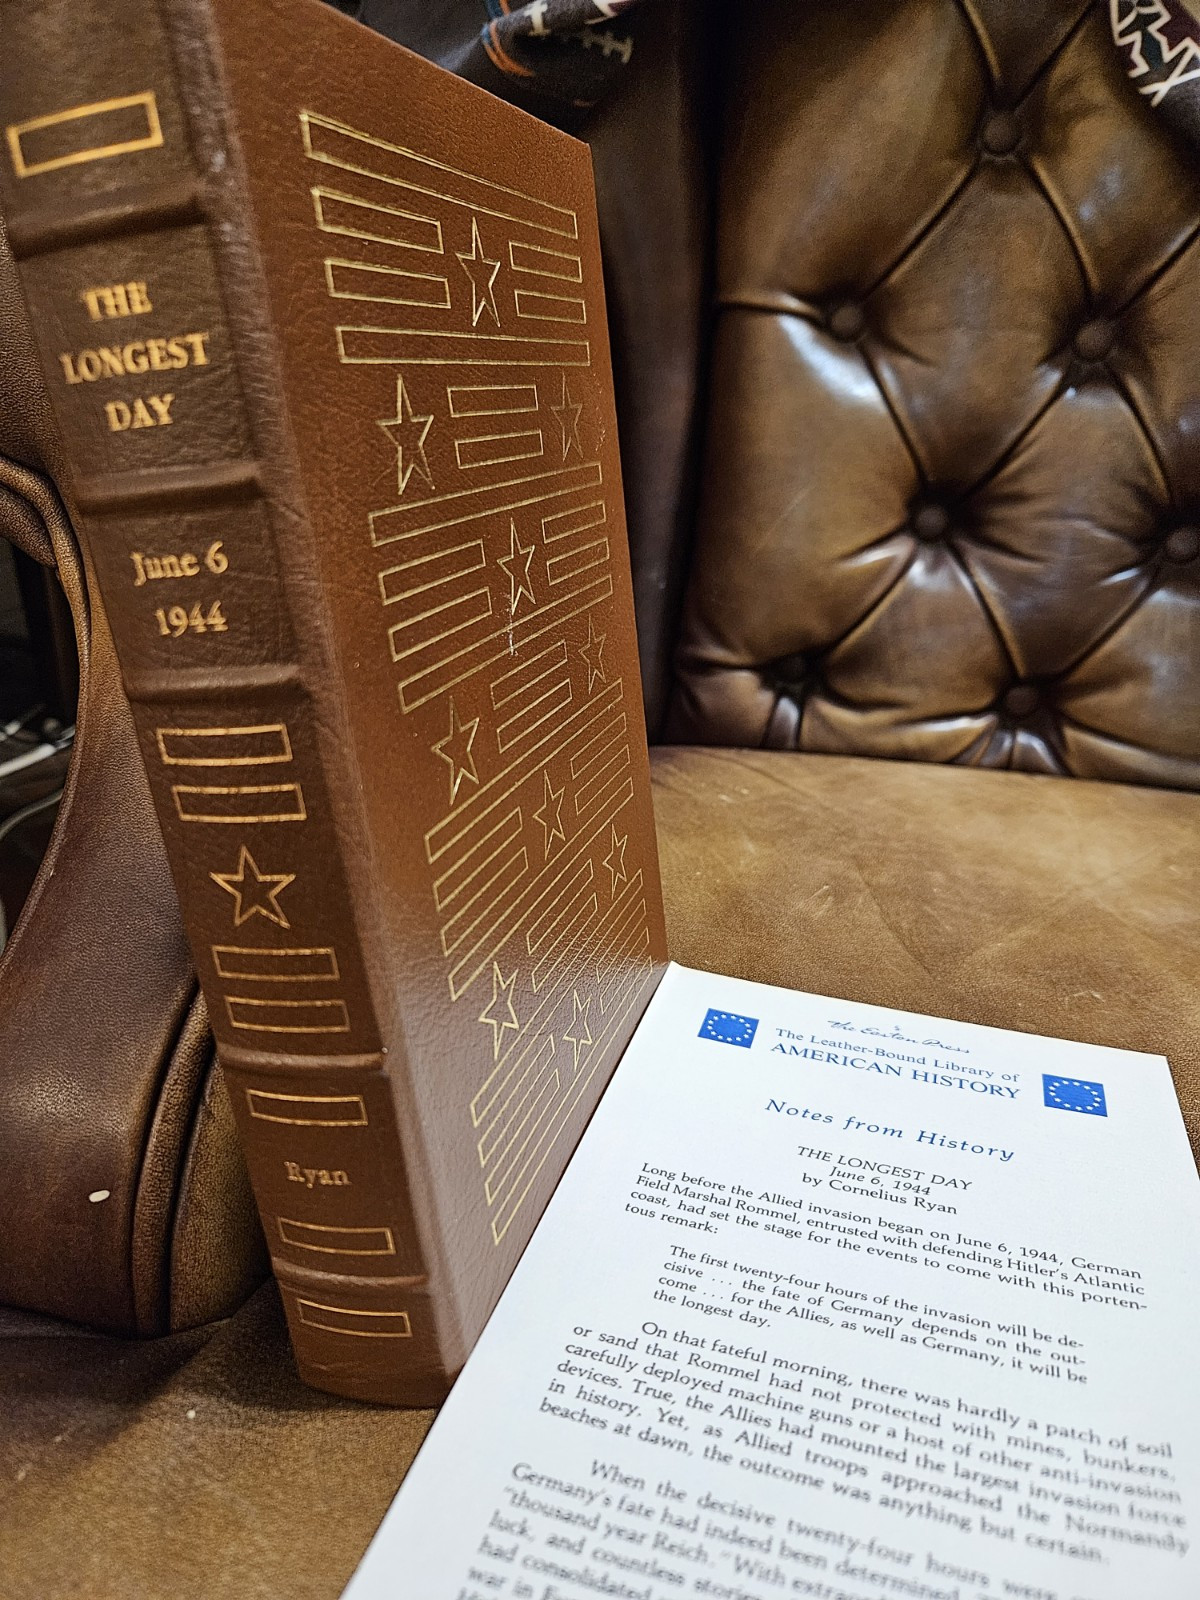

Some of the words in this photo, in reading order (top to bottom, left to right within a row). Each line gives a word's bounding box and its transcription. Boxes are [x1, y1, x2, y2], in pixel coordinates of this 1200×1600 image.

[81, 281, 153, 322] THE
[60, 332, 210, 385] LONGEST
[104, 393, 175, 432] DAY
[130, 551, 200, 587] June
[204, 540, 230, 574] 6
[154, 600, 229, 638] 1944
[771, 1042, 903, 1077] AMERICAN
[912, 1069, 1021, 1099] HISTORY
[776, 1028, 804, 1041] The
[810, 1035, 926, 1065] Leather-Bound
[934, 1059, 994, 1079] Library
[1001, 1073, 1020, 1082] of
[764, 1098, 833, 1123] Notes
[842, 1116, 902, 1138] from
[915, 1129, 1014, 1162] History
[797, 1145, 833, 1162] THE
[836, 1154, 925, 1181] LONGEST
[930, 1174, 972, 1190] DAY
[802, 1172, 823, 1187] by
[828, 1179, 907, 1204] Cornelius
[914, 1196, 957, 1215] Ryan
[828, 1165, 865, 1182] June
[870, 1176, 884, 1187] 6,
[892, 1180, 930, 1195] 1944
[624, 1203, 656, 1218] tous
[660, 1213, 718, 1234] remark:
[630, 1191, 670, 1208] coast,
[676, 1199, 706, 1215] had
[709, 1211, 729, 1221] set
[735, 1214, 759, 1228] the
[763, 1223, 802, 1239] stage
[807, 1230, 831, 1244] for
[836, 1237, 861, 1252] the
[866, 1246, 918, 1264] events
[924, 1257, 940, 1268] to
[946, 1263, 991, 1279] come
[997, 1274, 1036, 1289] with
[1043, 1281, 1074, 1297] this
[1081, 1291, 1147, 1310] porten-
[636, 1174, 670, 1192] Field
[672, 1184, 732, 1207] Marshal
[734, 1198, 800, 1224] Rommel,
[806, 1218, 878, 1240] entrusted
[882, 1235, 917, 1249] with
[922, 1241, 1003, 1268] defending
[1007, 1257, 1068, 1280] Hitler's
[1073, 1272, 1144, 1295] Atlantic
[641, 1162, 676, 1181] Long
[681, 1171, 726, 1191] before
[730, 1184, 753, 1198] the
[757, 1191, 803, 1209] Allied
[808, 1202, 871, 1224] invasion
[878, 1216, 923, 1236] began
[929, 1231, 950, 1241] on
[955, 1233, 992, 1250] June
[997, 1242, 1012, 1255] 6,
[1019, 1246, 1063, 1266] 1944,
[1071, 1256, 1141, 1279] German
[653, 1289, 676, 1304] the
[680, 1295, 733, 1318] longest
[738, 1310, 770, 1328] day.
[663, 1261, 703, 1278] cisive
[742, 1279, 765, 1293] the
[771, 1285, 800, 1301] fate
[807, 1296, 824, 1306] of
[830, 1299, 903, 1326] Germany
[911, 1317, 977, 1342] depends
[985, 1337, 1006, 1349] on
[1015, 1341, 1041, 1356] the
[1050, 1352, 1085, 1364] out-
[670, 1244, 696, 1261] The
[699, 1252, 728, 1269] first
[733, 1262, 821, 1290] twenty-four
[824, 1281, 868, 1301] hours
[872, 1294, 890, 1306] of
[894, 1298, 918, 1312] the
[923, 1304, 991, 1329] invasion
[997, 1323, 1026, 1337] will
[1032, 1327, 1052, 1342] be
[1057, 1334, 1084, 1348] de-
[658, 1276, 697, 1292] come
[730, 1291, 754, 1306] for
[758, 1298, 782, 1313] the
[785, 1306, 834, 1327] Allies,
[840, 1320, 857, 1331] as
[863, 1325, 895, 1339] well
[900, 1334, 917, 1345] as
[922, 1336, 1004, 1367] Germany,
[1012, 1356, 1022, 1369] it
[1029, 1363, 1060, 1378] will
[1067, 1368, 1087, 1384] be
[565, 1344, 638, 1373] carefully
[643, 1363, 724, 1393] deployed
[728, 1387, 804, 1414] machine
[808, 1408, 853, 1427] guns
[859, 1421, 880, 1434] or
[886, 1428, 896, 1438] a
[904, 1426, 943, 1450] host
[952, 1443, 971, 1457] of
[979, 1450, 1031, 1472] other
[573, 1326, 592, 1337] or
[598, 1333, 639, 1350] sand
[645, 1342, 678, 1361] that
[687, 1352, 760, 1382] Rommel
[768, 1372, 803, 1392] had
[811, 1387, 841, 1402] not
[851, 1397, 941, 1427] protected
[952, 1422, 995, 1441] with
[1006, 1435, 1071, 1462] mines,
[641, 1321, 667, 1339] On
[672, 1330, 706, 1348] that
[710, 1338, 767, 1364] fateful
[772, 1357, 852, 1387] morning,
[861, 1377, 908, 1398] there
[914, 1391, 950, 1409] was
[957, 1397, 1020, 1428] hardly
[1027, 1419, 1038, 1430] a
[1046, 1424, 1101, 1445] patch
[1108, 1435, 1127, 1451] of
[539, 1396, 608, 1430] beaches
[612, 1424, 631, 1436] at
[637, 1426, 693, 1456] dawn,
[702, 1444, 733, 1465] the
[739, 1458, 824, 1489] outcome
[832, 1481, 871, 1503] was
[878, 1496, 971, 1534] anything
[980, 1515, 1015, 1542] but
[548, 1378, 565, 1394] in
[575, 1384, 641, 1417] history.
[658, 1406, 688, 1431] Yet,
[702, 1425, 722, 1438] as
[734, 1430, 793, 1456] Allied
[805, 1449, 868, 1477] troops
[881, 1472, 1002, 1512] approached
[1017, 1502, 1050, 1525] the
[557, 1359, 622, 1389] devices.
[632, 1378, 676, 1405] True,
[685, 1394, 714, 1412] the
[719, 1404, 771, 1428] Allies
[778, 1416, 814, 1439] had
[820, 1432, 907, 1463] mounted
[915, 1453, 946, 1472] the
[953, 1461, 1019, 1492] largest
[1029, 1483, 1120, 1516] invasion
